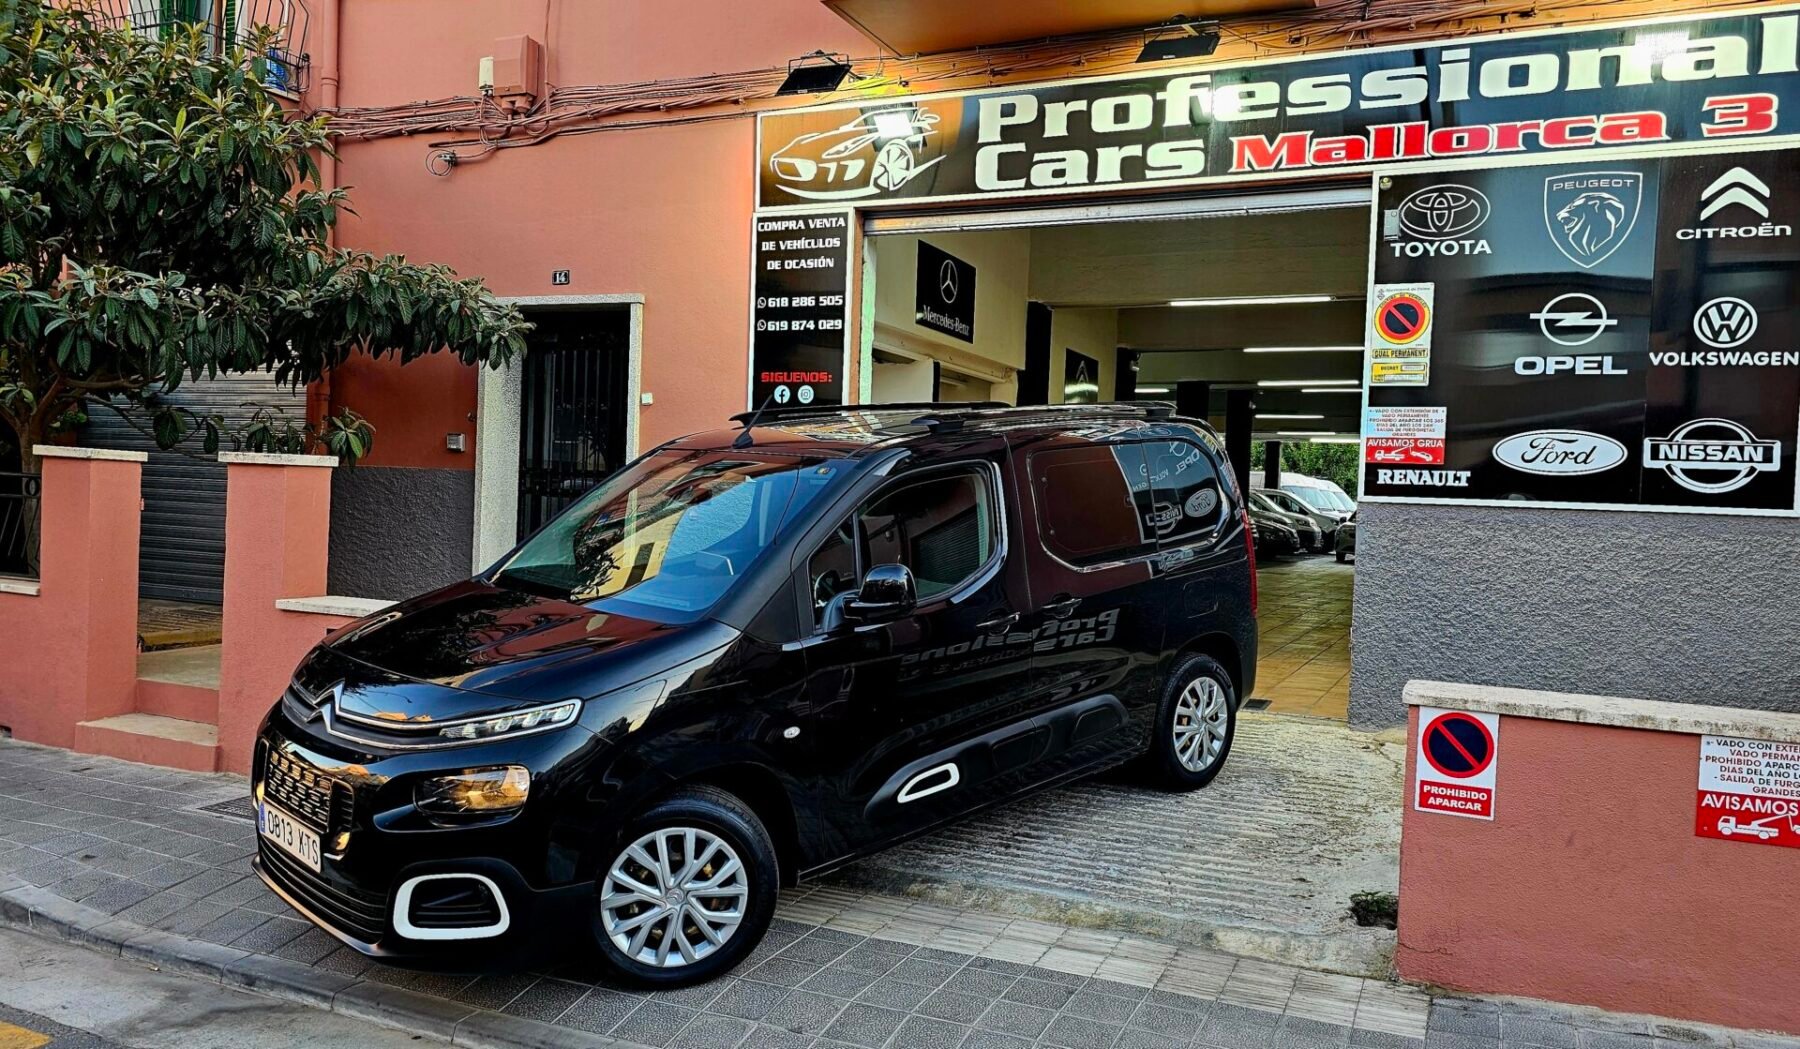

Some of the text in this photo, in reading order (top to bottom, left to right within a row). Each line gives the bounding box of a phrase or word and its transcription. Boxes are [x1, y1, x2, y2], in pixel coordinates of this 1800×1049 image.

[977, 16, 1800, 143] Professional
[976, 93, 1779, 191] Cars Mallorca 3
[1552, 178, 1635, 191] PEUGEOT
[757, 217, 846, 232] COMPRA VENTA
[761, 237, 841, 251] DE VEHÍCULOS
[1390, 239, 1492, 257] TOYOTA
[766, 256, 835, 270] DE OCASIÓN
[768, 295, 843, 308] 618 286 505
[767, 319, 842, 331] 619 874 029
[923, 304, 970, 336] Mercedes-Benz
[1391, 349, 1426, 357] PERMANENT
[1649, 351, 1799, 366] VOLKSWAGEN
[1514, 355, 1628, 375] OPEL
[761, 371, 832, 383] SIGUENOS:
[1367, 438, 1444, 448] AVISAMOS GRUA
[1520, 439, 1598, 466] Ford
[1658, 444, 1765, 462] NISSAN
[1377, 469, 1471, 487] RENAULT
[1716, 739, 1800, 753] VADO CON EXTE
[1730, 749, 1758, 758] VADO
[1705, 756, 1761, 767] PROHIBIDO
[1720, 766, 1744, 774] DIAS
[1747, 768, 1764, 776] DEL
[1767, 769, 1790, 779] AÑO
[1720, 774, 1755, 784] SALIDA
[1423, 784, 1488, 801] PROHIBIDO
[1752, 786, 1800, 797] GRANDES
[1427, 797, 1482, 811] APARCAR
[1701, 794, 1799, 816] AVISAMOS
[268, 810, 294, 847] 0813
